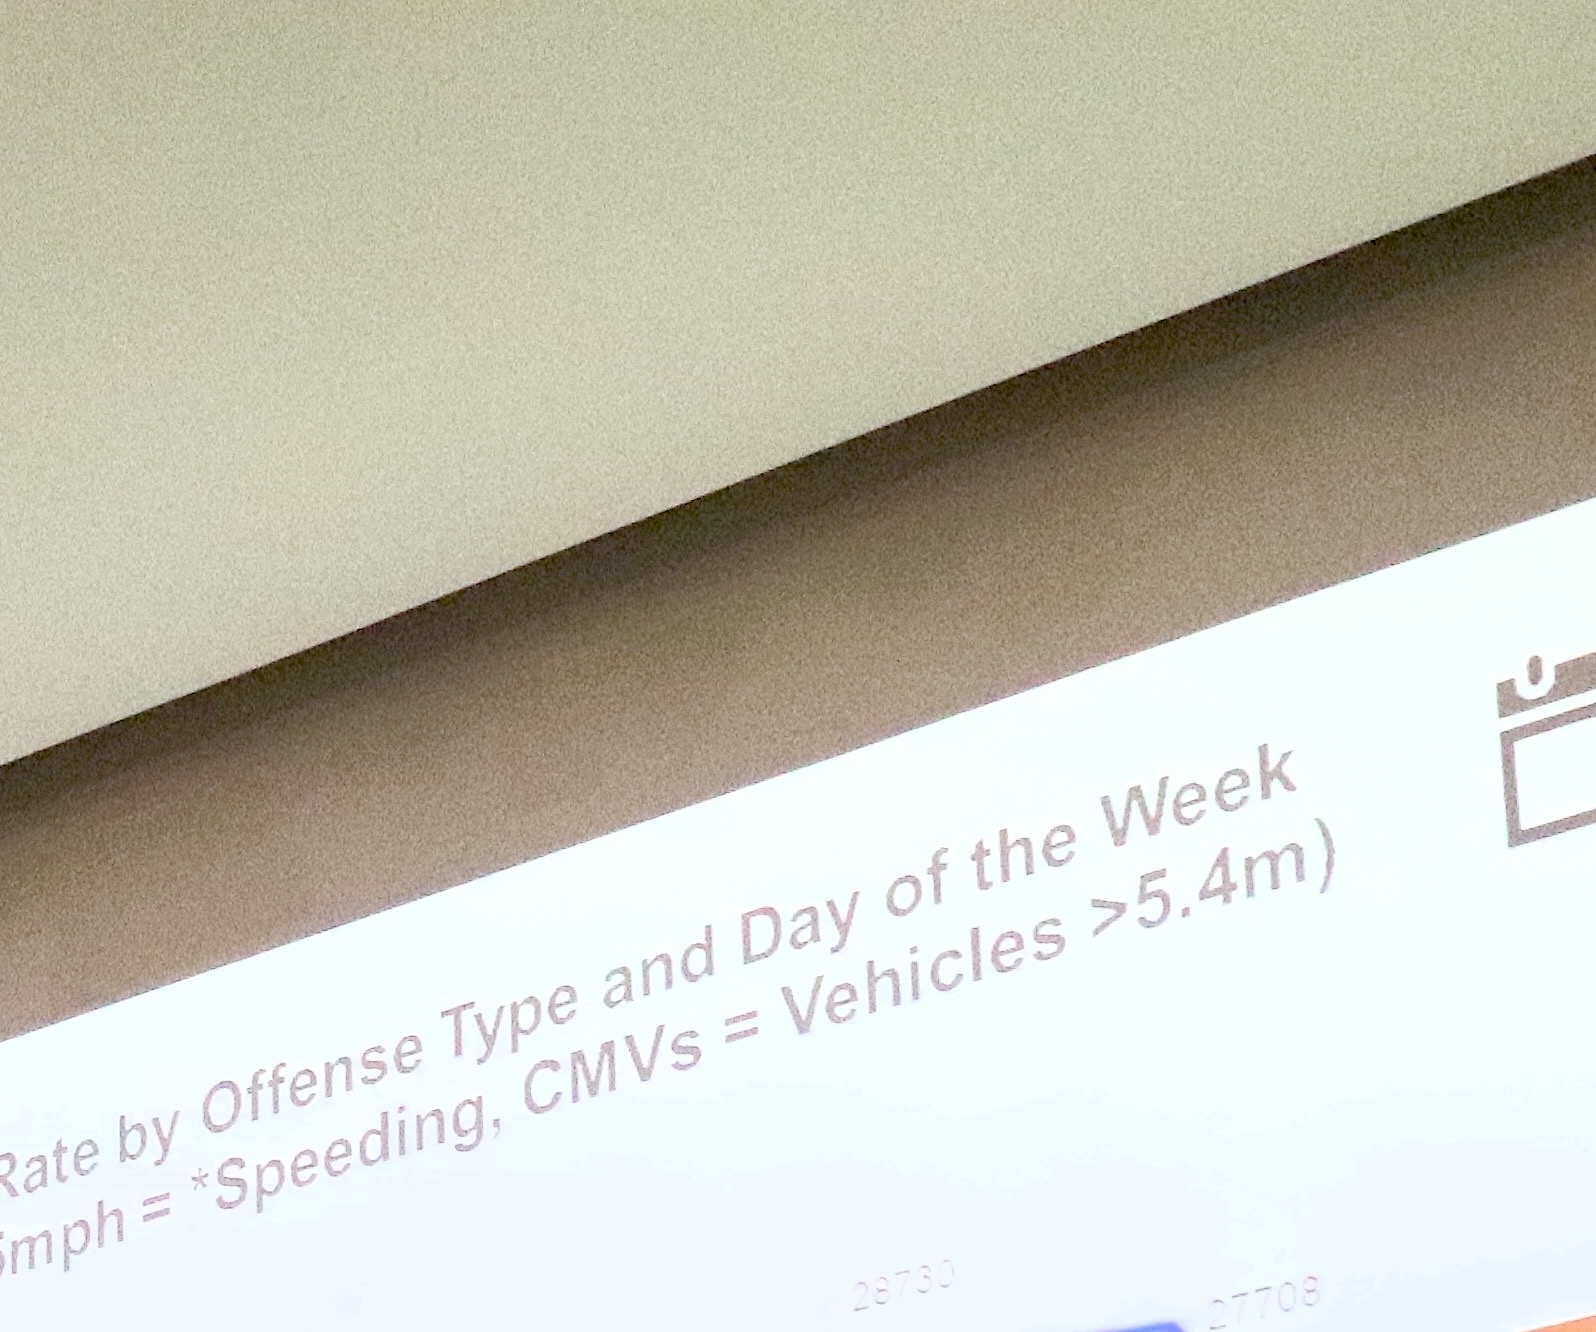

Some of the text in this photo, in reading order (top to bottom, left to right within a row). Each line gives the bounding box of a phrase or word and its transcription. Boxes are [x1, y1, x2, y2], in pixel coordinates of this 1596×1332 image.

[118, 1109, 180, 1166] by
[201, 1034, 423, 1134] Offense
[440, 984, 578, 1066] Type
[603, 924, 716, 1009] and
[740, 890, 860, 966] Day
[885, 846, 950, 918] of
[971, 822, 1077, 891] the
[1099, 742, 1298, 848] Week
[141, 1192, 171, 1224] =
[523, 1023, 703, 1116] CMVs
[724, 1010, 760, 1045] =
[780, 915, 1068, 1037] Vehicles
[1090, 815, 1337, 939] >5.4m)
[850, 1257, 957, 1314] 28730
[1207, 1273, 1323, 1332] 27708
